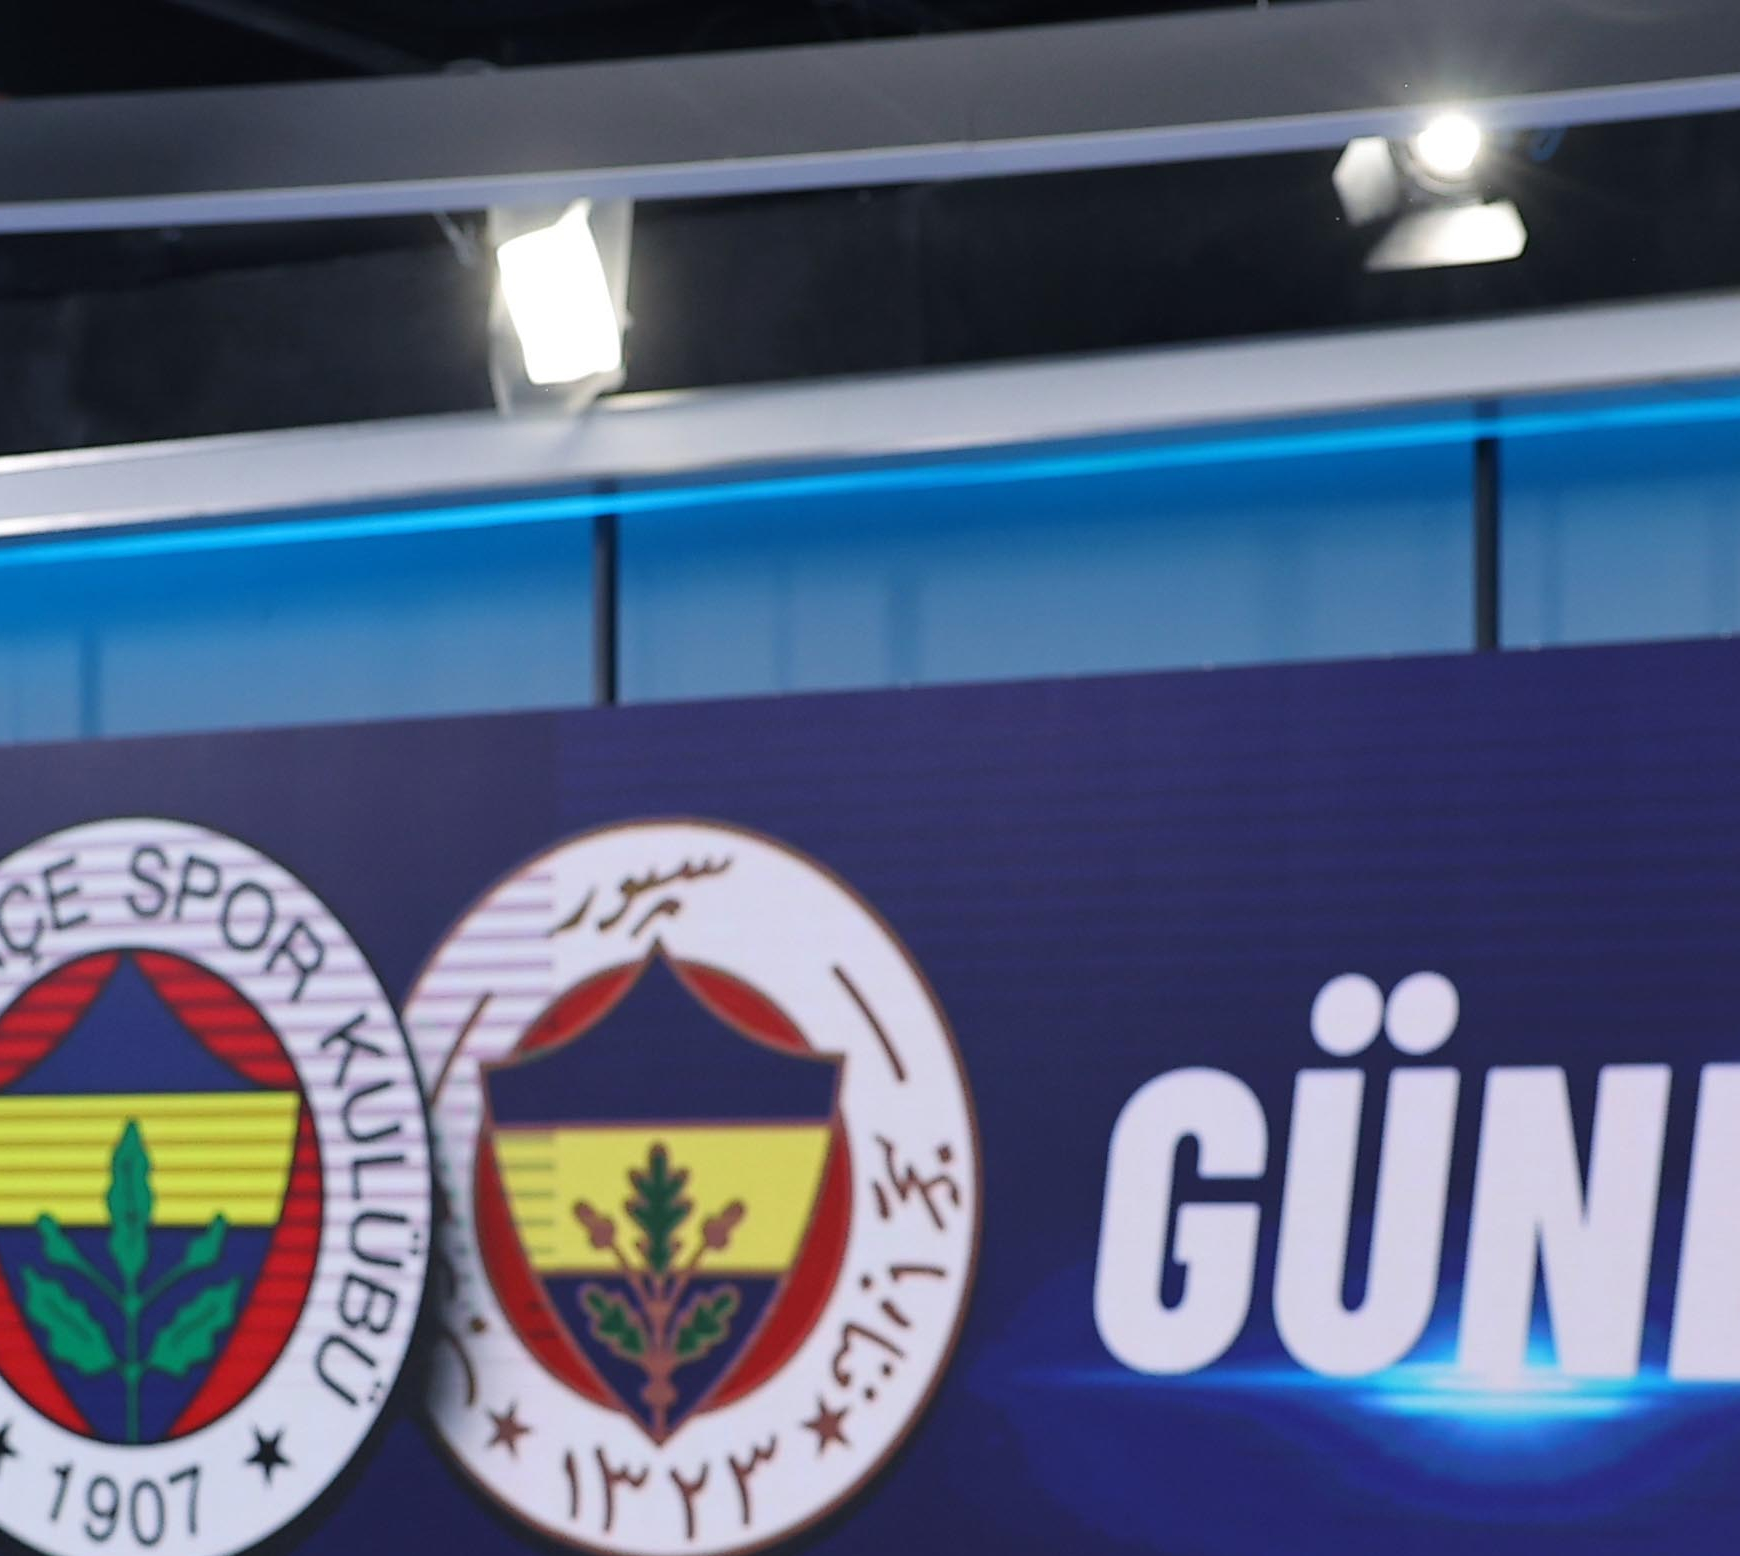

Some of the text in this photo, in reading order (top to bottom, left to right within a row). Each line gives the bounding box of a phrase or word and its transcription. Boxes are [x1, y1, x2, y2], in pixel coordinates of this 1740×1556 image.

[124, 844, 327, 1001] SPOR
[314, 1012, 425, 1408] KULÜBÜ
[49, 1464, 203, 1546] 1907
